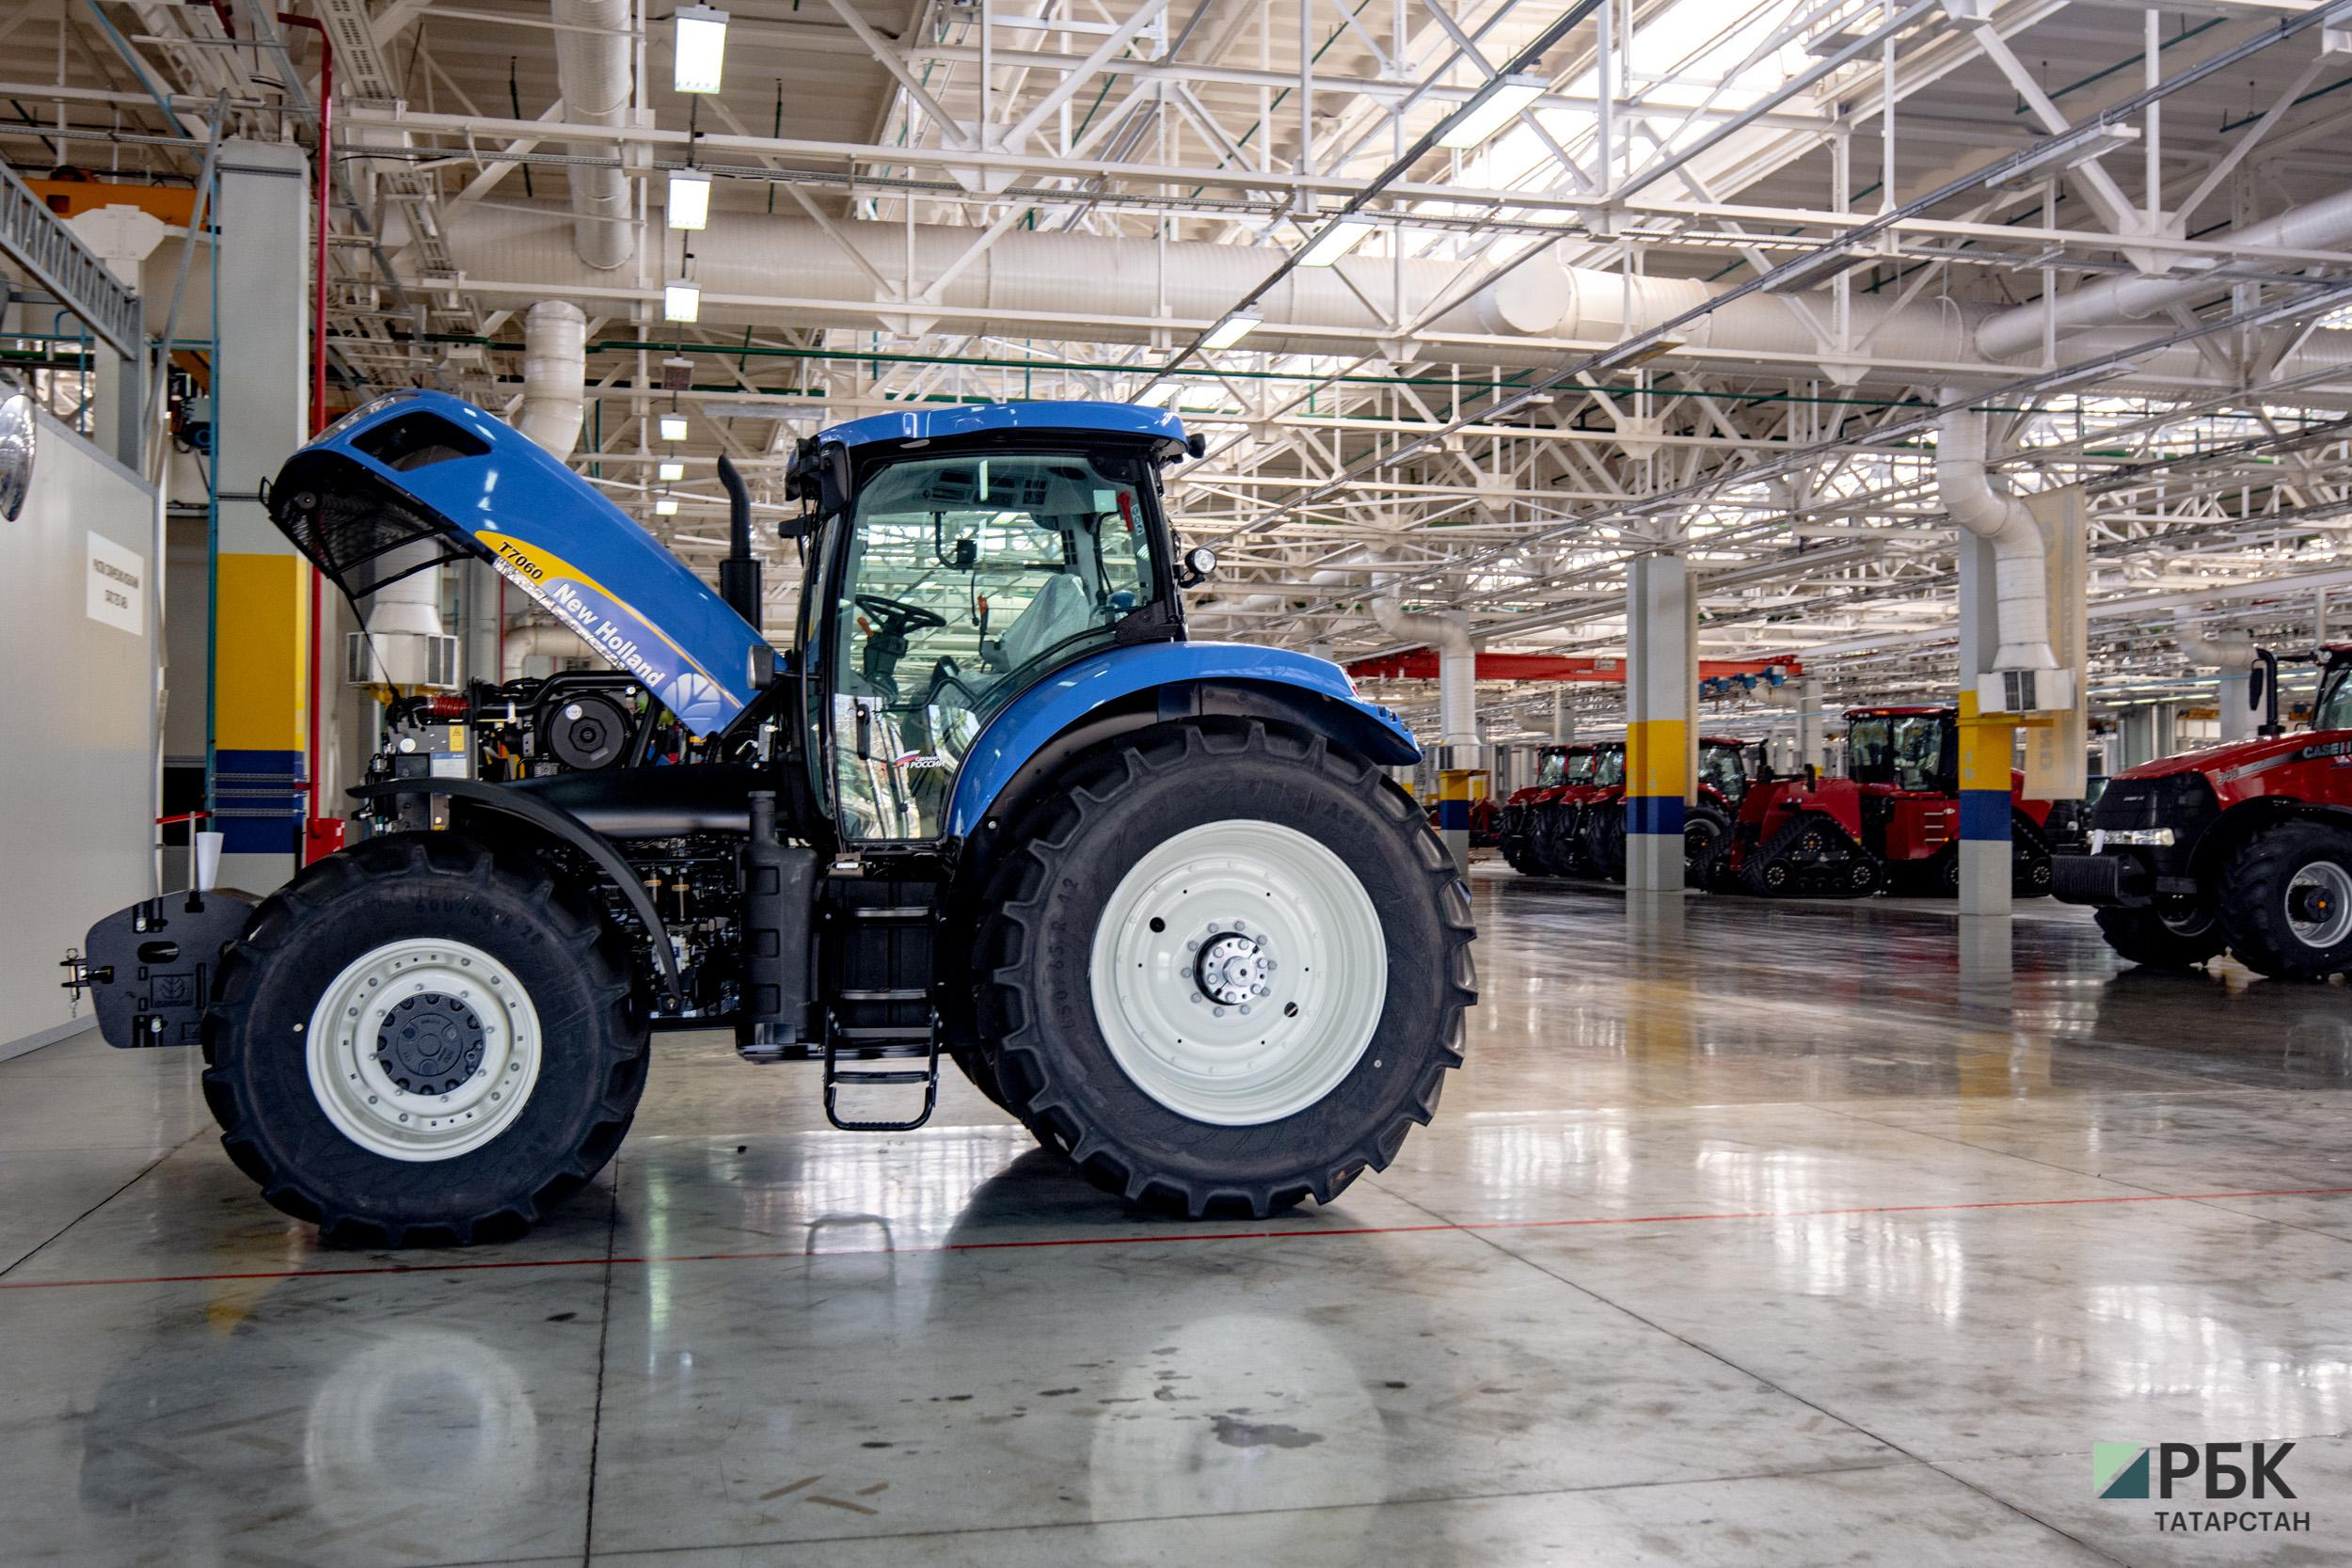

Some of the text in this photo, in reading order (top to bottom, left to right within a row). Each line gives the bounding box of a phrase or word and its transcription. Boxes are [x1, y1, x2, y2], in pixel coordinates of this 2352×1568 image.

[499, 541, 544, 579] T7060
[551, 582, 666, 688] New Holland
[2302, 743, 2339, 758] CASE
